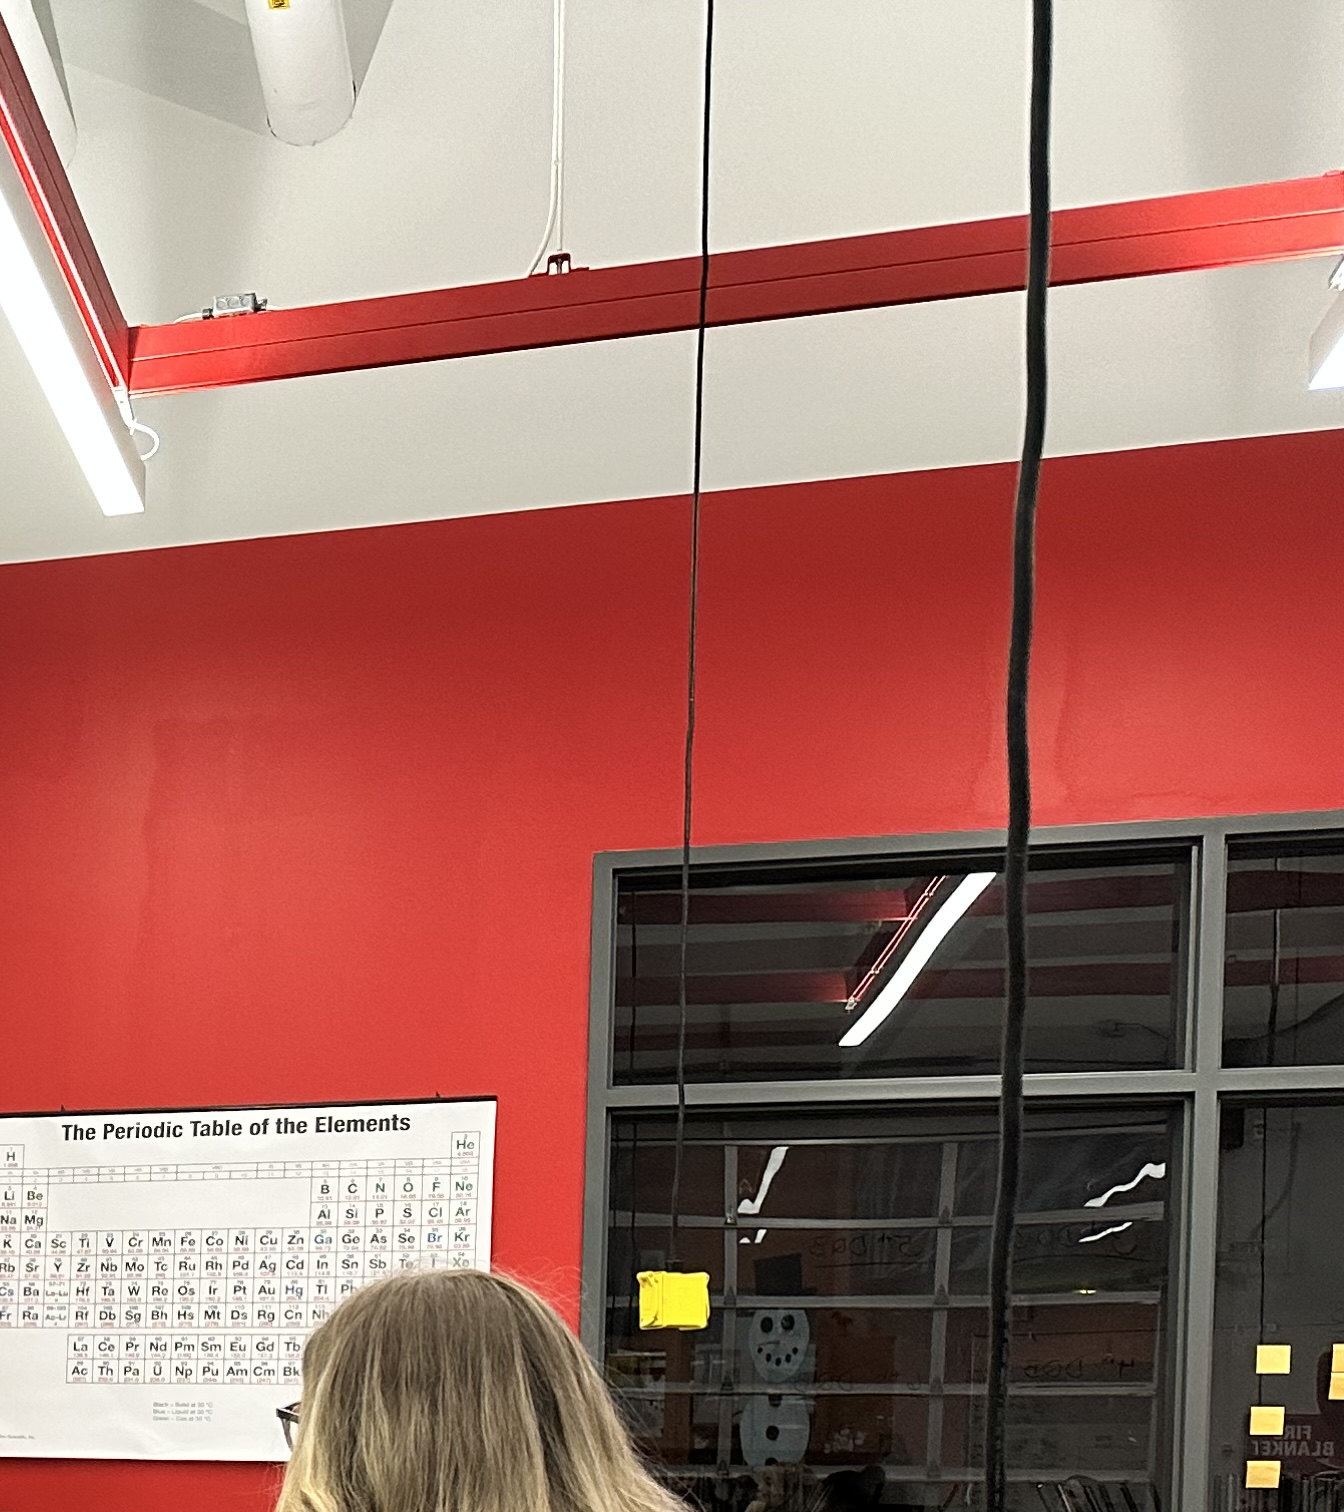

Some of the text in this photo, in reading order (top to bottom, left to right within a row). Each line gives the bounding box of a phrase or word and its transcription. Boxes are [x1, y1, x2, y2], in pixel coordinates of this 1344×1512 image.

[62, 1114, 410, 1141] The Periodic Table of the Elements
[7, 1140, 474, 1161] H He
[5, 1182, 473, 1200] Li Be B C N O F Ne
[0, 1207, 471, 1227] Na Mg Al Si P S Cl Ar
